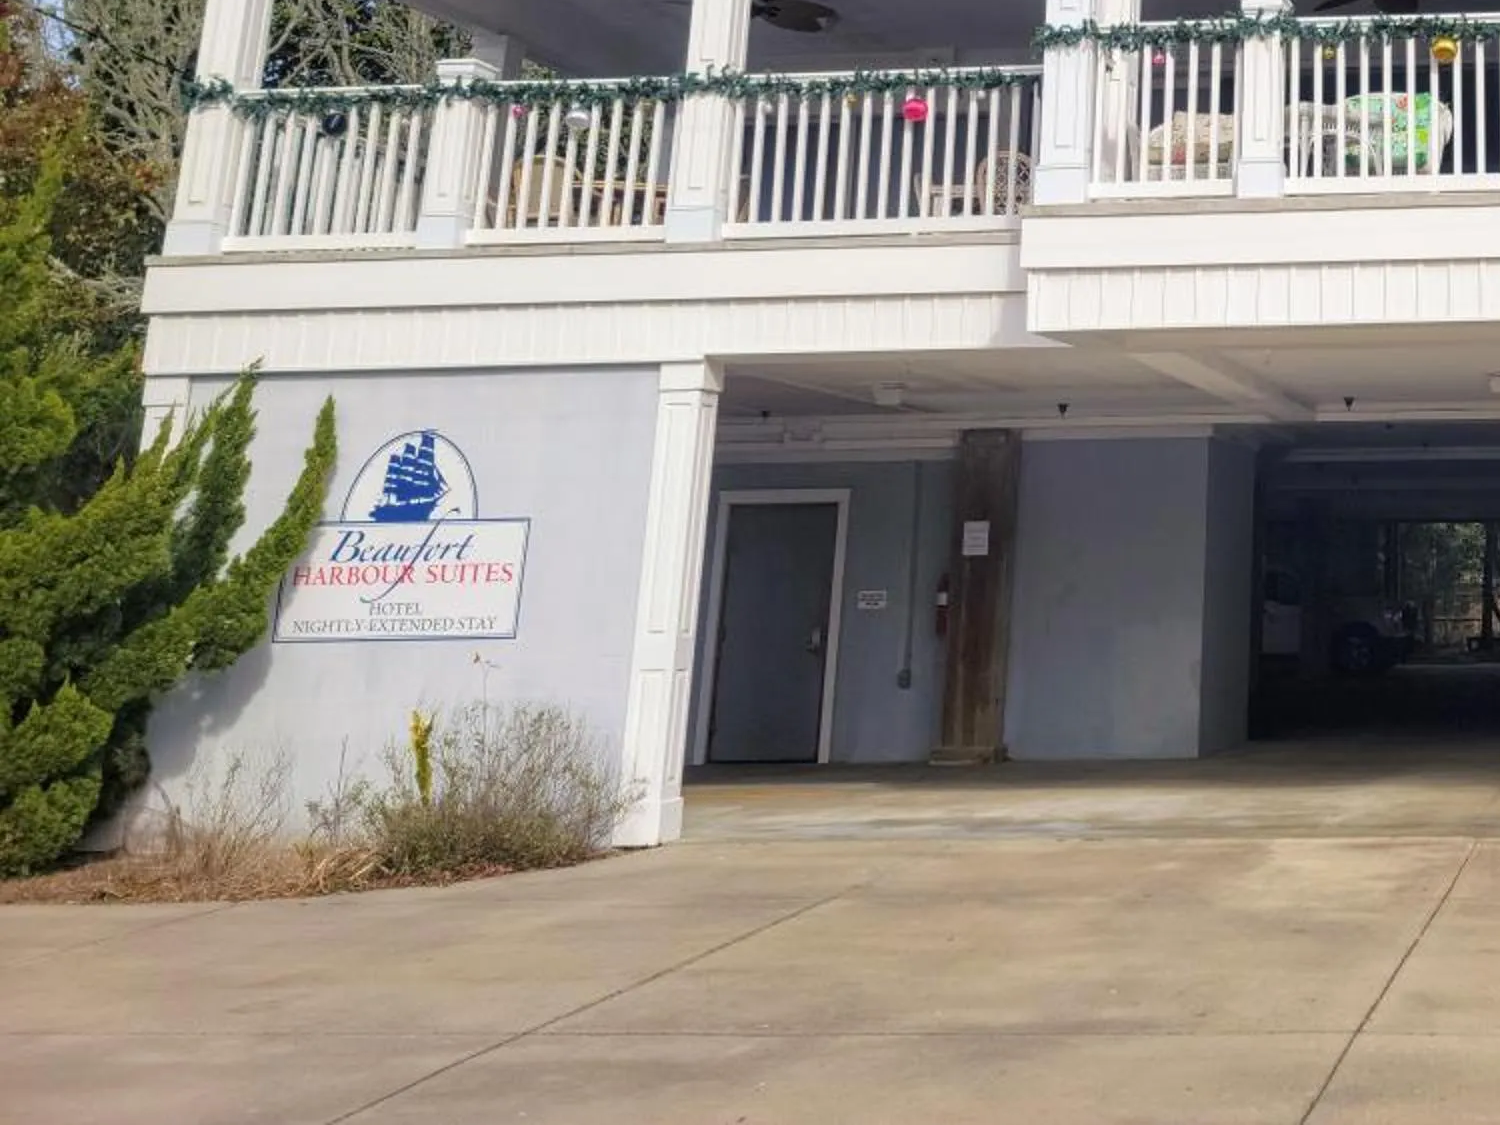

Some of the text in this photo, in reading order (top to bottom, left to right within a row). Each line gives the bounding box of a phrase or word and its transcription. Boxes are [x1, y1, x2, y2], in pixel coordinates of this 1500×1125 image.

[292, 562, 514, 587] HARBOUR SUITES
[369, 602, 423, 616] HOTEL
